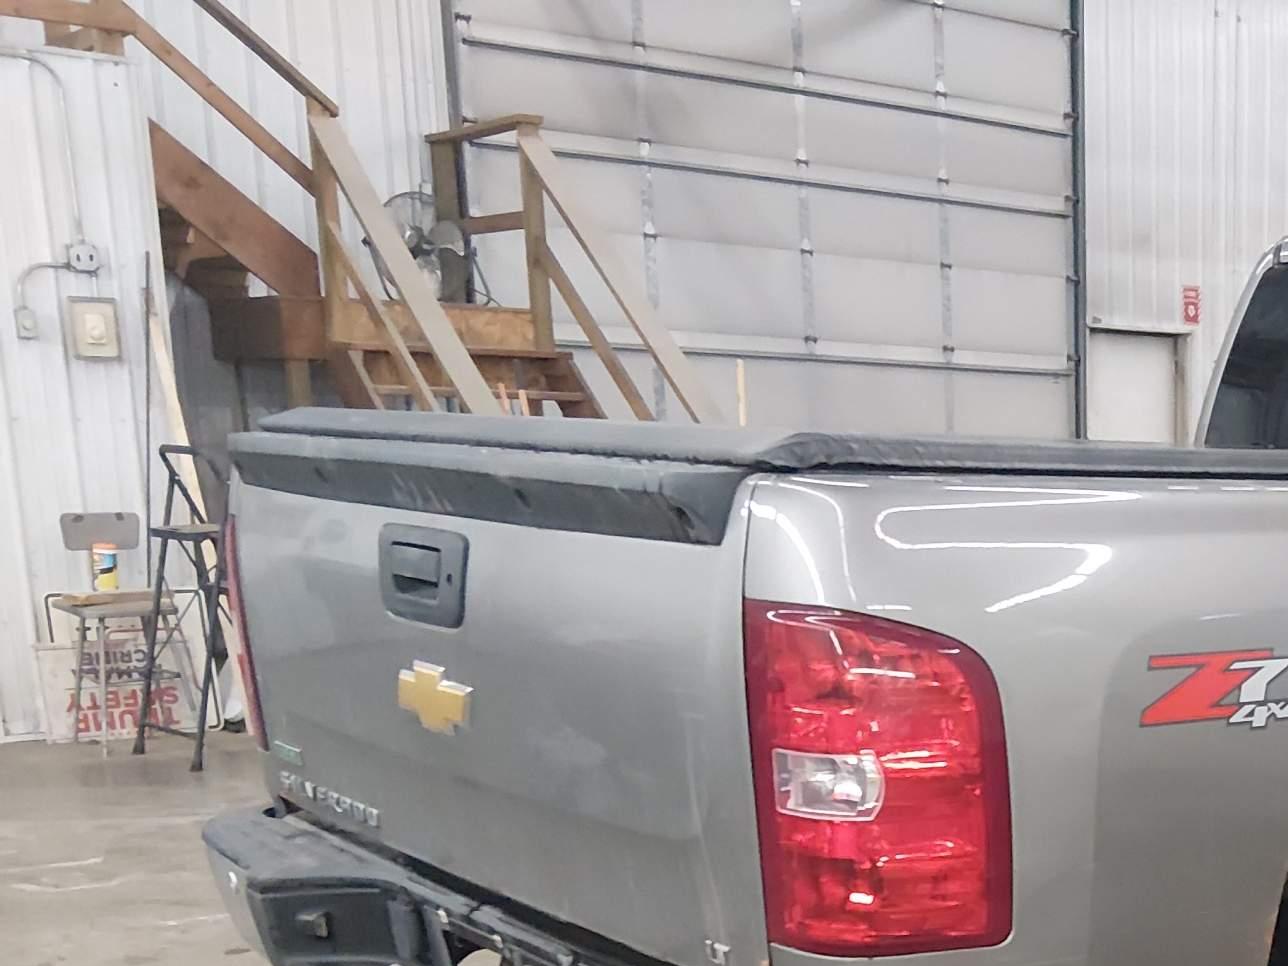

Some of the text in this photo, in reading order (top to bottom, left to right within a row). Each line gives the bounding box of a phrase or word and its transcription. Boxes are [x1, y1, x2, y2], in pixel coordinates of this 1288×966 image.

[80, 648, 148, 667] CRIME
[66, 685, 180, 713] SAFETY
[76, 708, 180, 734] TRUMP
[704, 939, 731, 966] LT
